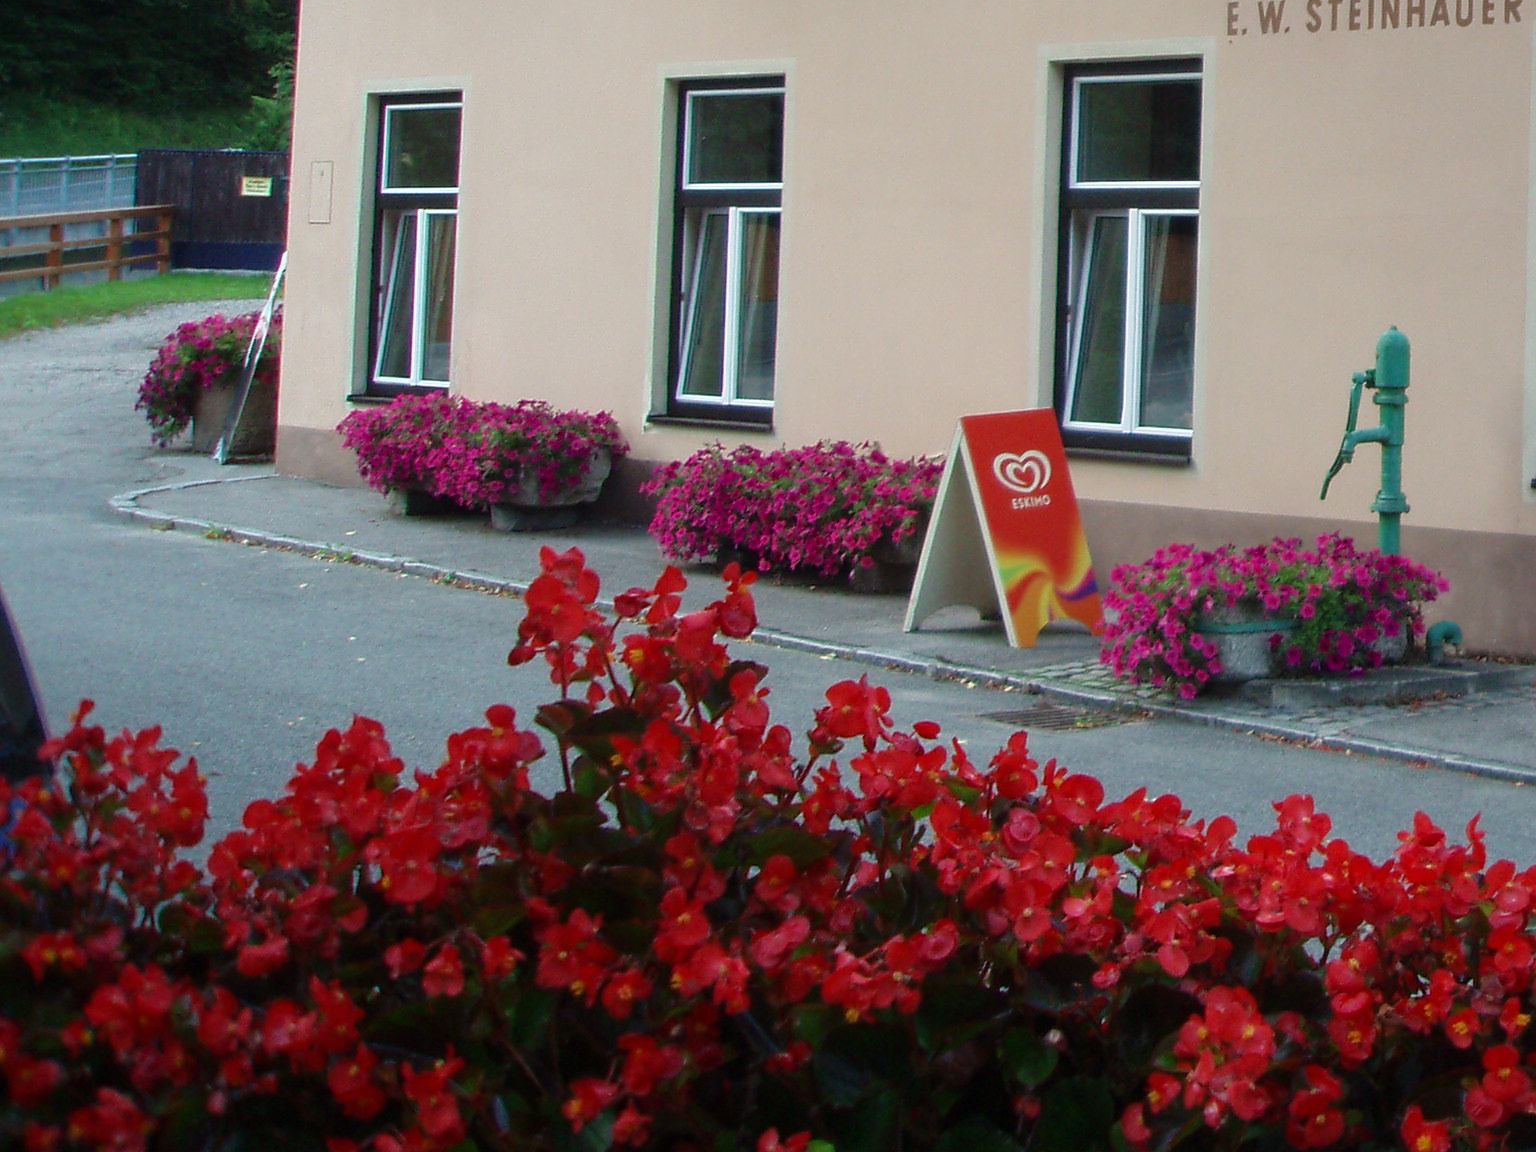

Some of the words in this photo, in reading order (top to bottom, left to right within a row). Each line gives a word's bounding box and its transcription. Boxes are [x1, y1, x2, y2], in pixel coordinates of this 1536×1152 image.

[1226, 1, 1248, 36] E.
[1258, 0, 1291, 35] W.
[1011, 495, 1051, 510] ESKIMO
